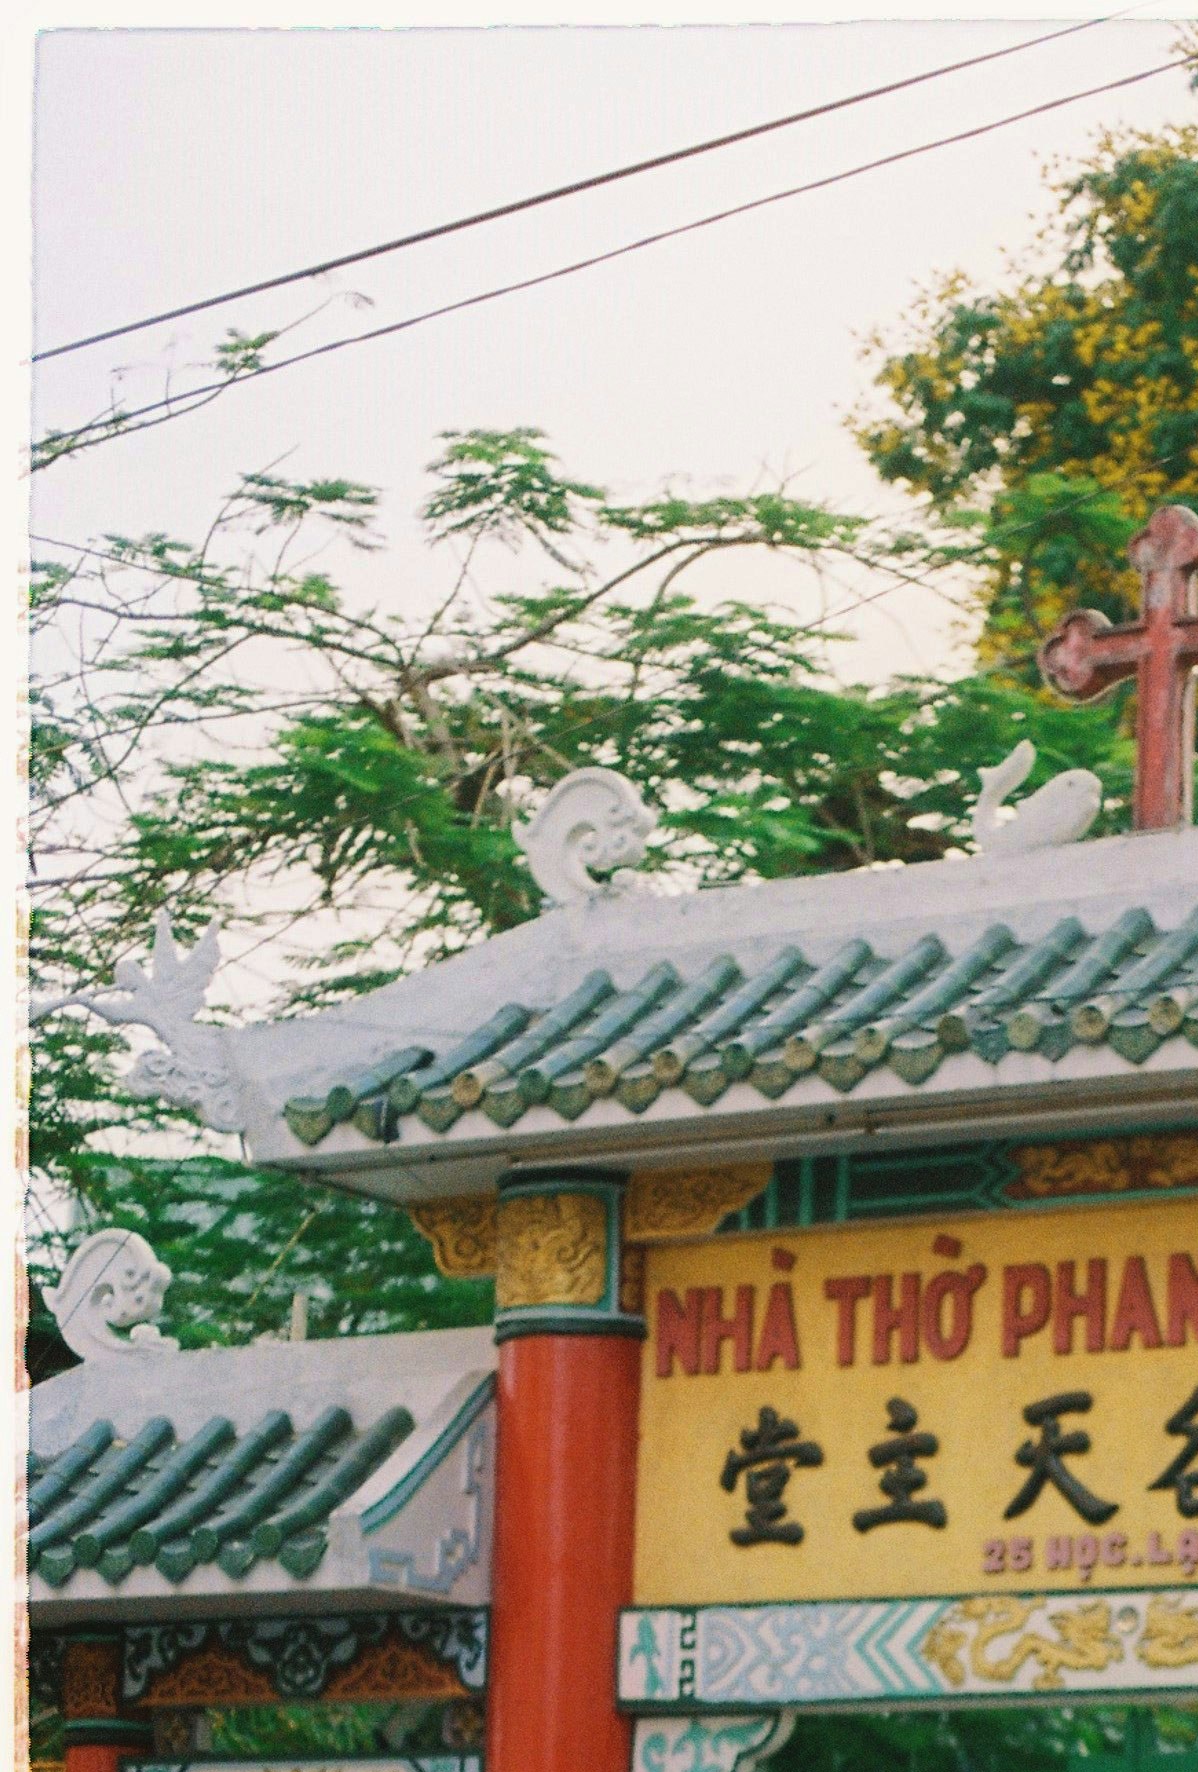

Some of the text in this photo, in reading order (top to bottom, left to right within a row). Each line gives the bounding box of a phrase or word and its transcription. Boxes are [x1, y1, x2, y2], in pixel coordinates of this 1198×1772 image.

[656, 1246, 801, 1378] NHÀ
[823, 1232, 988, 1369] THỜ
[981, 1535, 1034, 1574] 25
